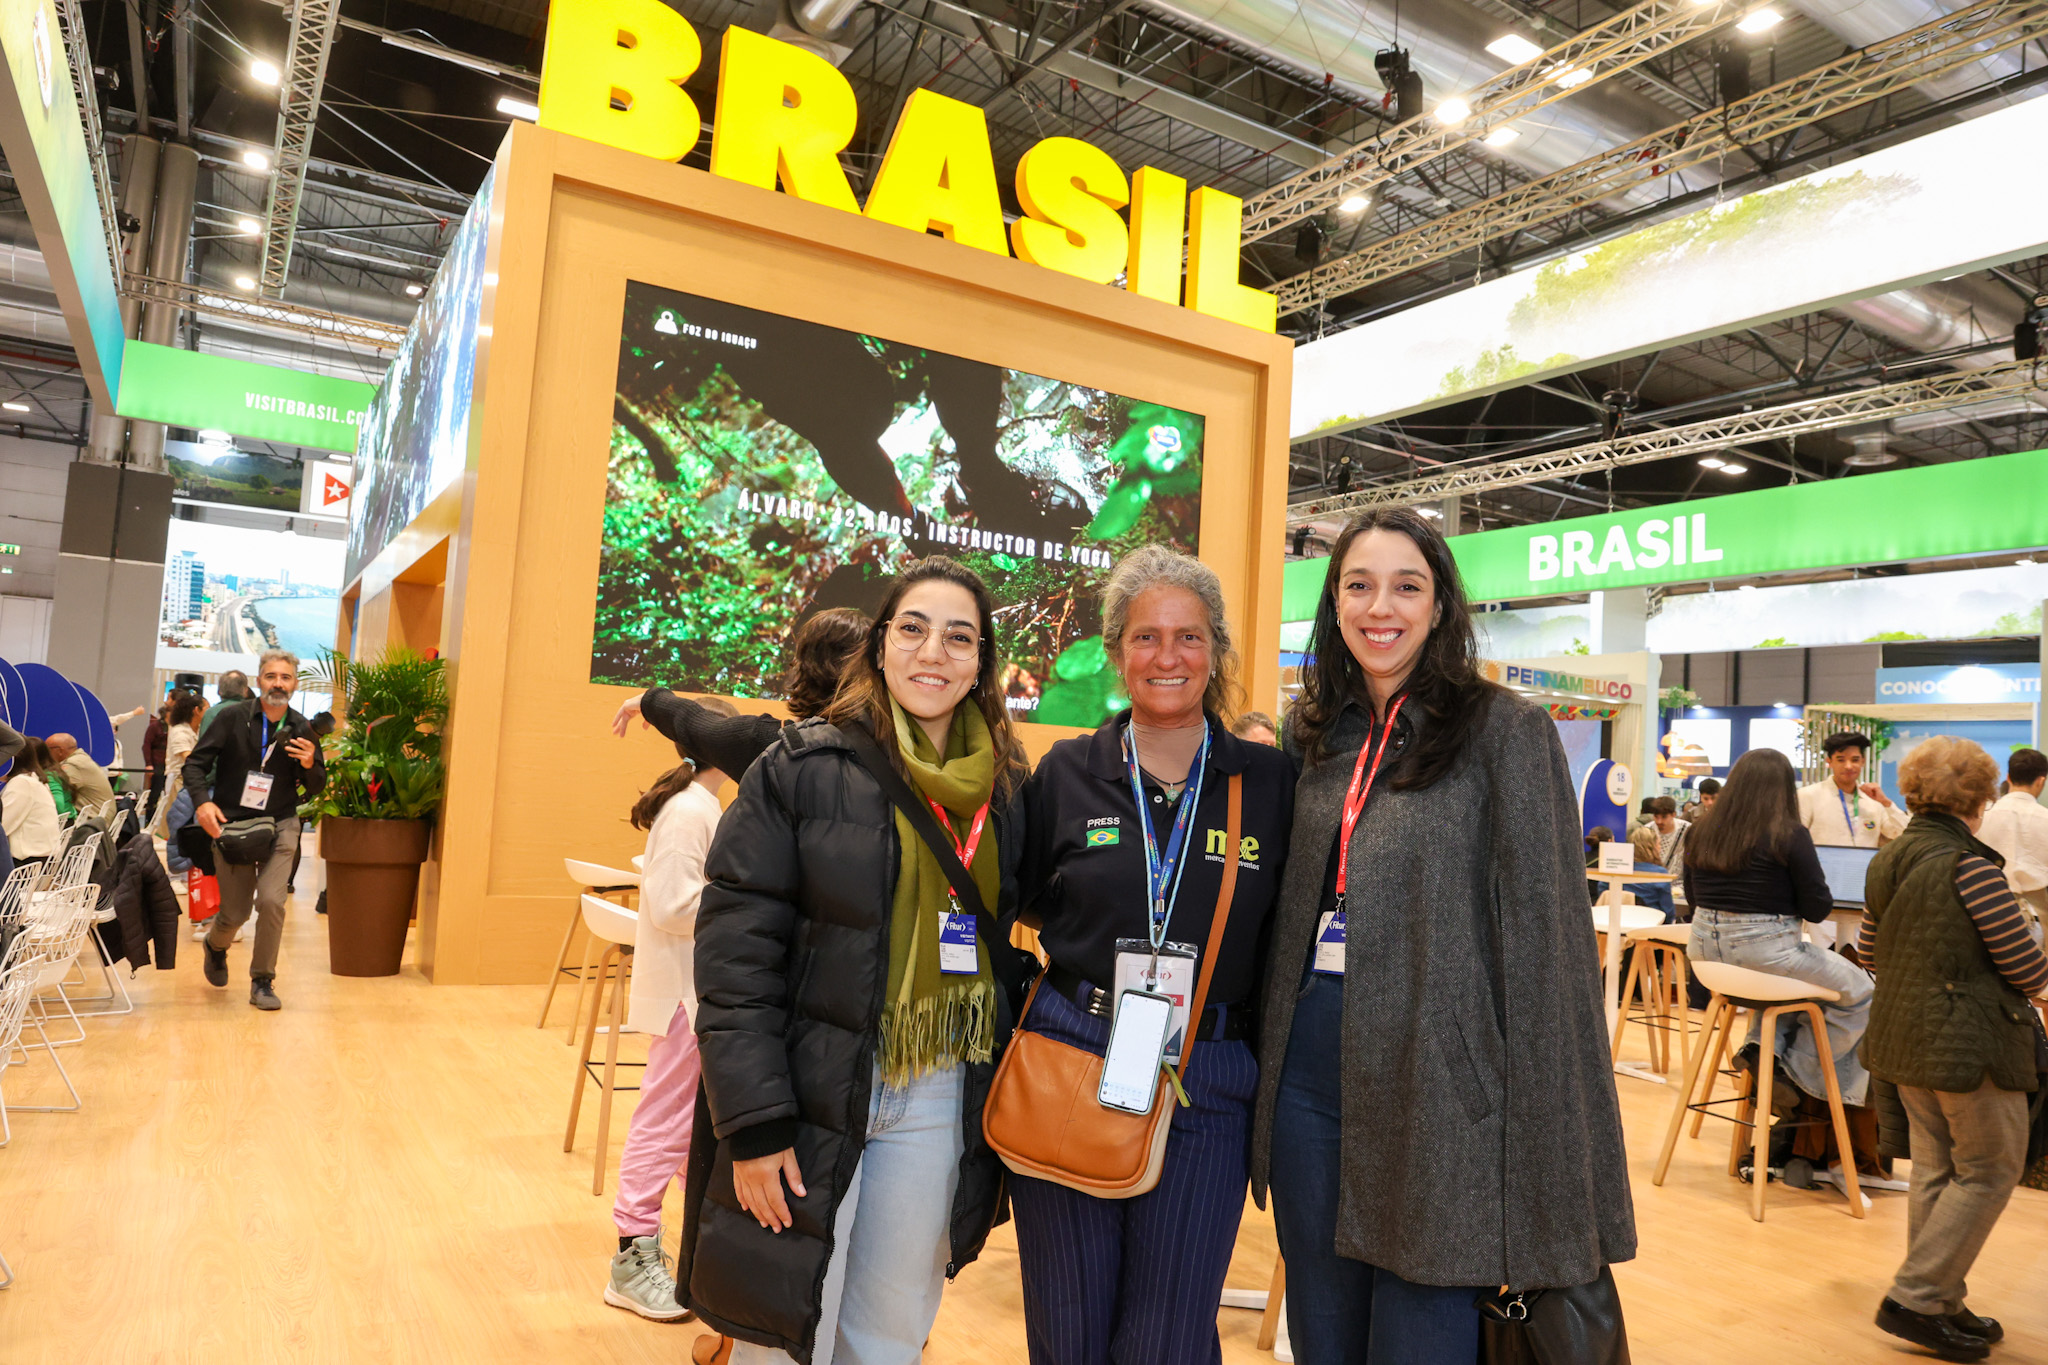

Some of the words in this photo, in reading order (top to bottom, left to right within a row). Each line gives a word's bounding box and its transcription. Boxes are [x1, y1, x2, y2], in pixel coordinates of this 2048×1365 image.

[538, 0, 1277, 334] BRASIL
[683, 323, 702, 337] FOZ
[704, 327, 719, 341] DO
[721, 331, 757, 350] IGUAÇU
[245, 391, 365, 426] VISITBRASIL.CO
[737, 488, 822, 525] ÁLVARO,
[831, 507, 856, 528] 42
[864, 511, 920, 541] AÑOS,
[928, 521, 1036, 558] INSTRUCTOR
[1043, 541, 1064, 562] DE
[1071, 545, 1112, 570] YOGA
[1528, 513, 1724, 582] BRASIL
[1507, 665, 1632, 699] PERNAMBUCO
[1086, 816, 1120, 828] PRESS
